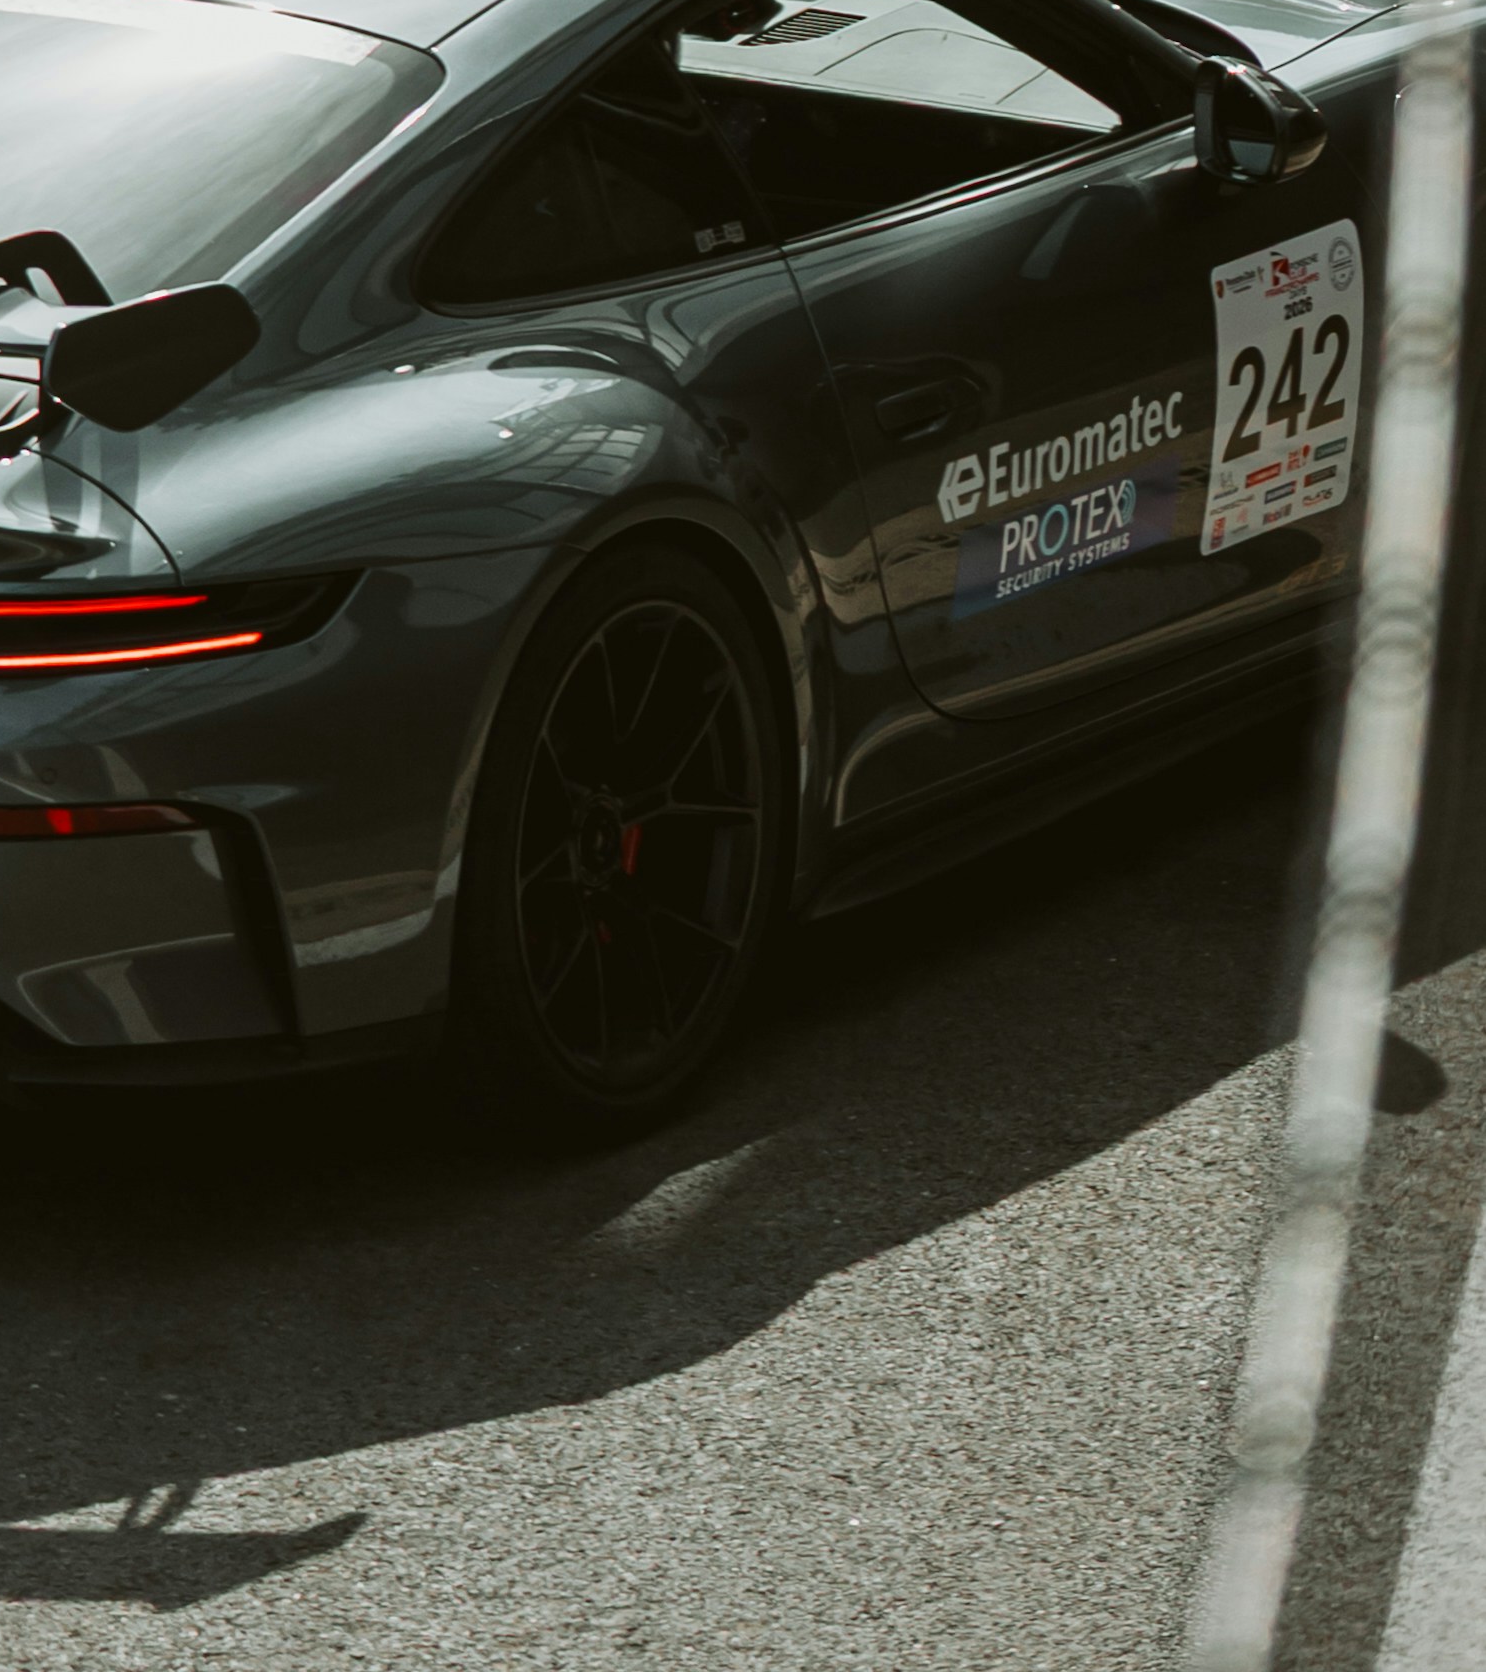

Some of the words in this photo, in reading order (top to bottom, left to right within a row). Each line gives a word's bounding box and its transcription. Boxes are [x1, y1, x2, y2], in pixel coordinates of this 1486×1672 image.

[1284, 296, 1314, 321] 2026
[1222, 314, 1350, 464] 242
[987, 391, 1183, 508] Euromatec
[996, 558, 1064, 599] SECURITY
[1068, 532, 1130, 572] SYSTEMS
[1000, 480, 1130, 574] PROTEX
